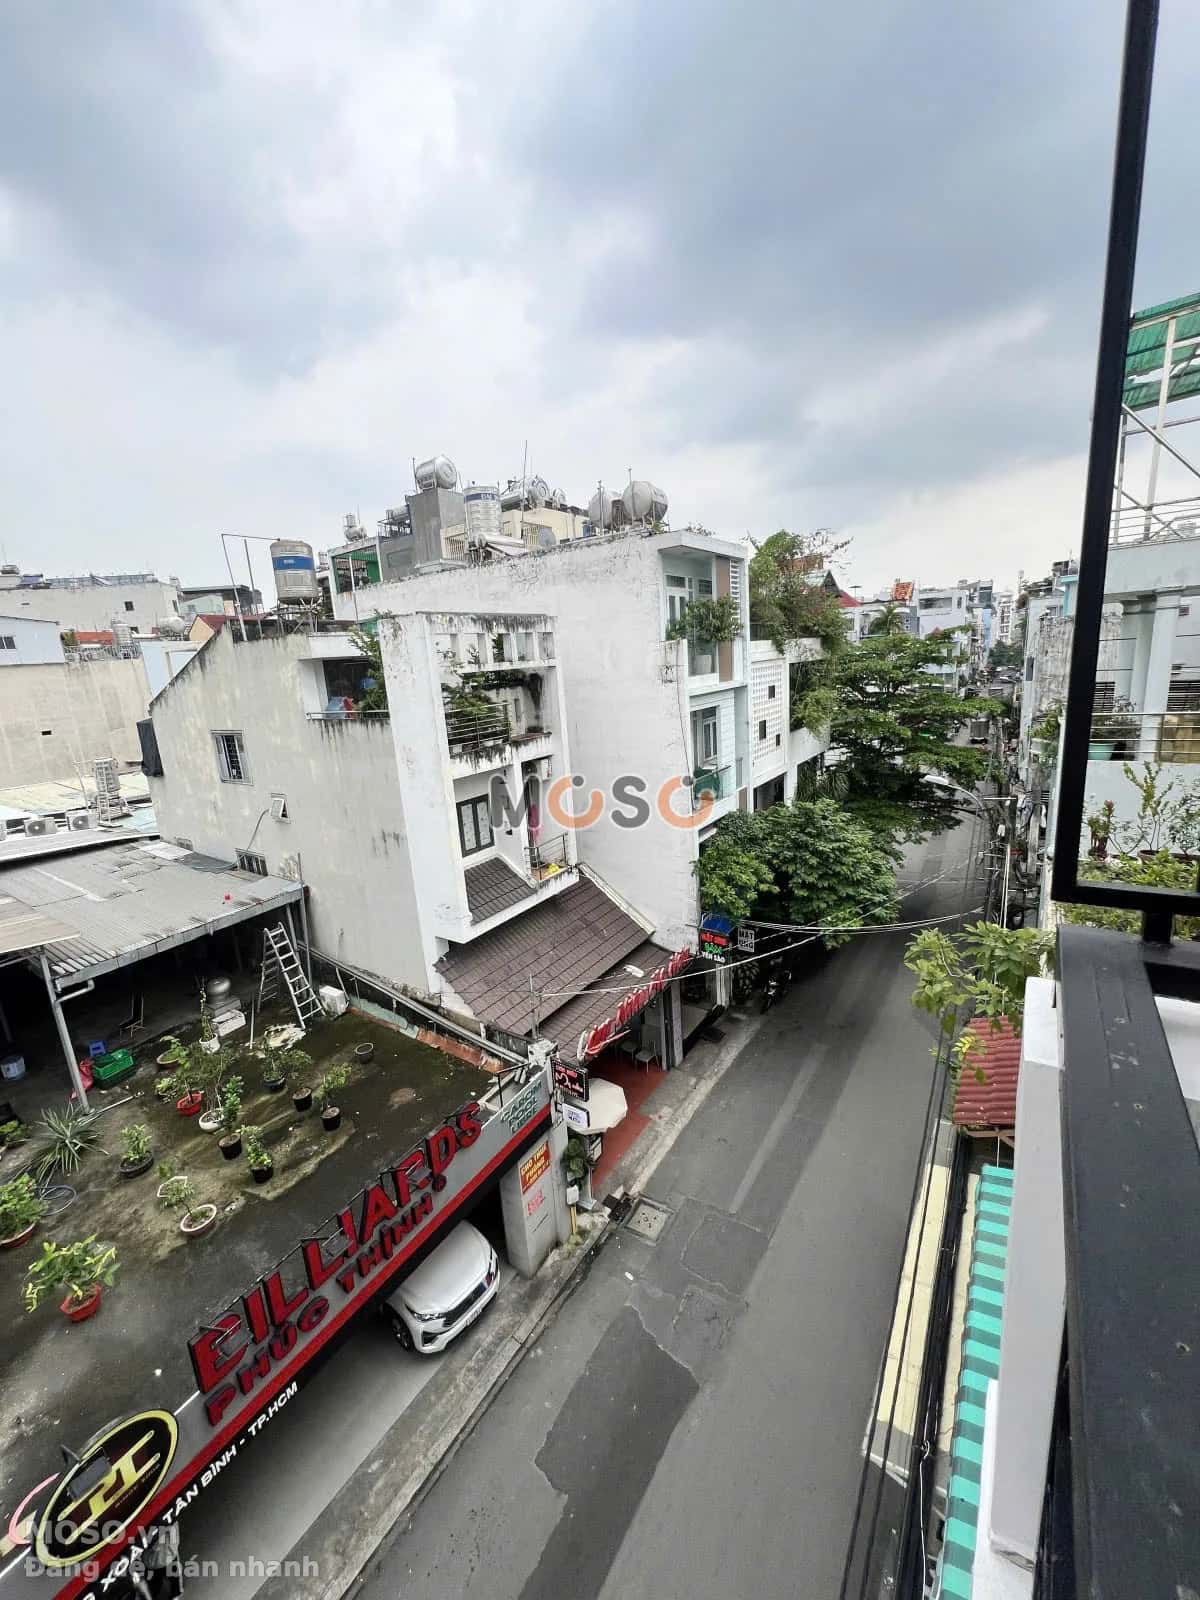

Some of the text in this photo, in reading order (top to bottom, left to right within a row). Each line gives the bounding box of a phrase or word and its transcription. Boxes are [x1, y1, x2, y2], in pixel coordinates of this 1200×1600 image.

[162, 1484, 199, 1524] TÂN
[200, 1444, 238, 1488] BÌNH
[247, 1381, 298, 1438] TP.HCM
